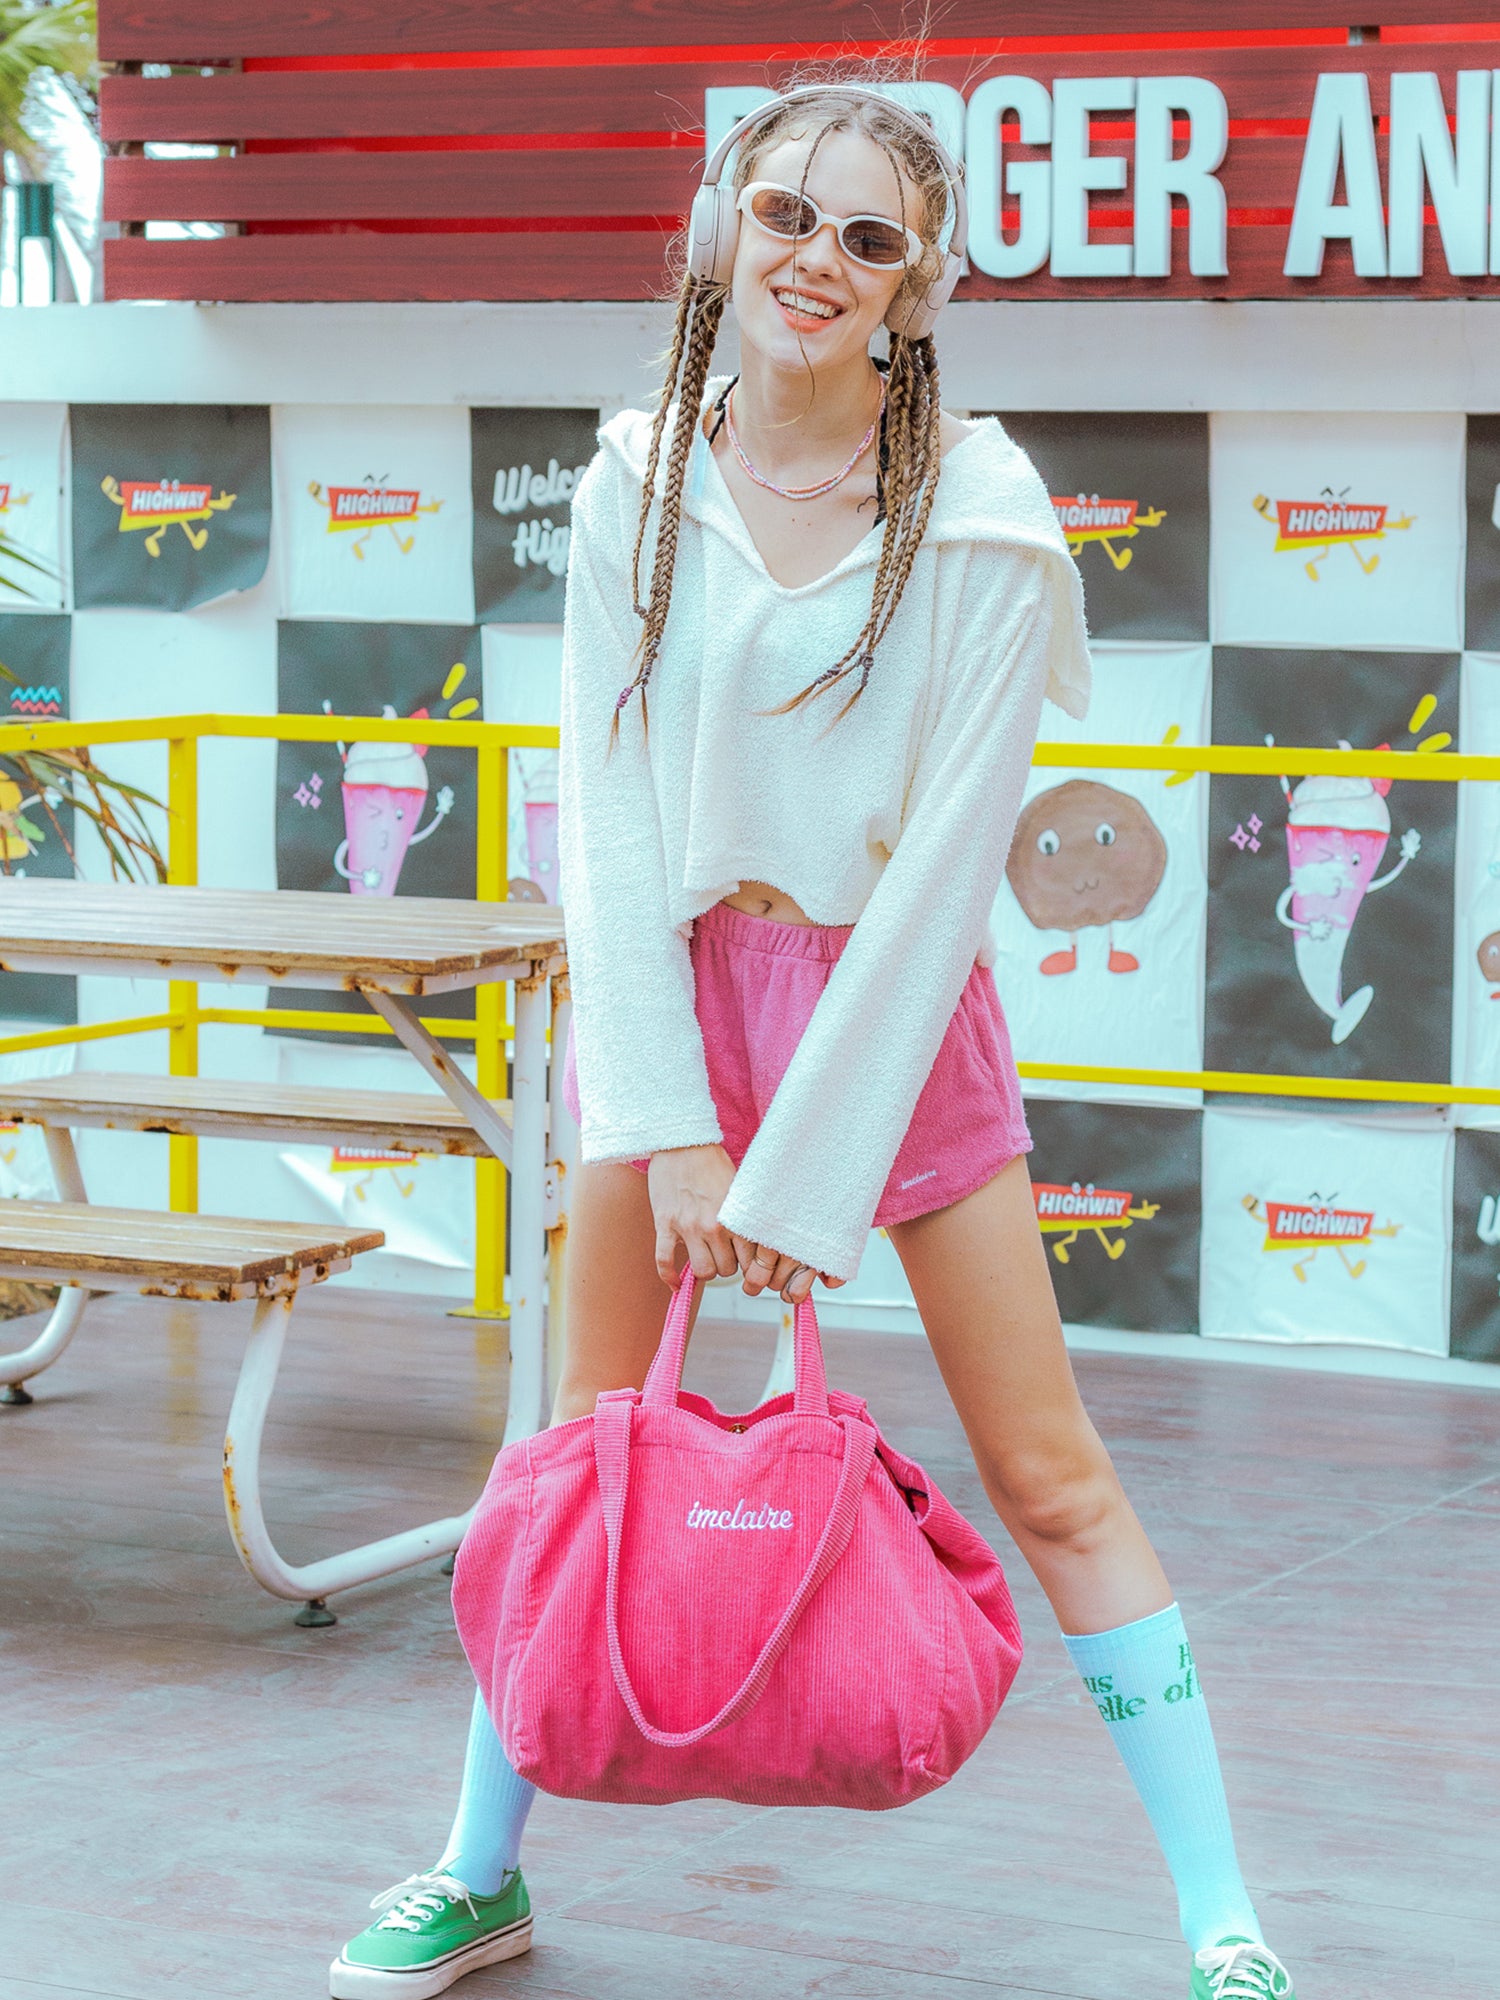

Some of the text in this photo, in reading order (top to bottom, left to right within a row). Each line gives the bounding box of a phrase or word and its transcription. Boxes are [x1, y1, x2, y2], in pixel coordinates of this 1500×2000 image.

[704, 68, 1500, 279] GER AN
[492, 458, 588, 515] Welc
[131, 489, 207, 512] HIGHWAY
[335, 492, 416, 516] HIGHWAY
[1287, 508, 1381, 532] HIGHWAY
[1038, 1191, 1126, 1217] HIGHWAY
[1275, 1209, 1369, 1236] HIGHWAY
[686, 1498, 794, 1530] imclaire
